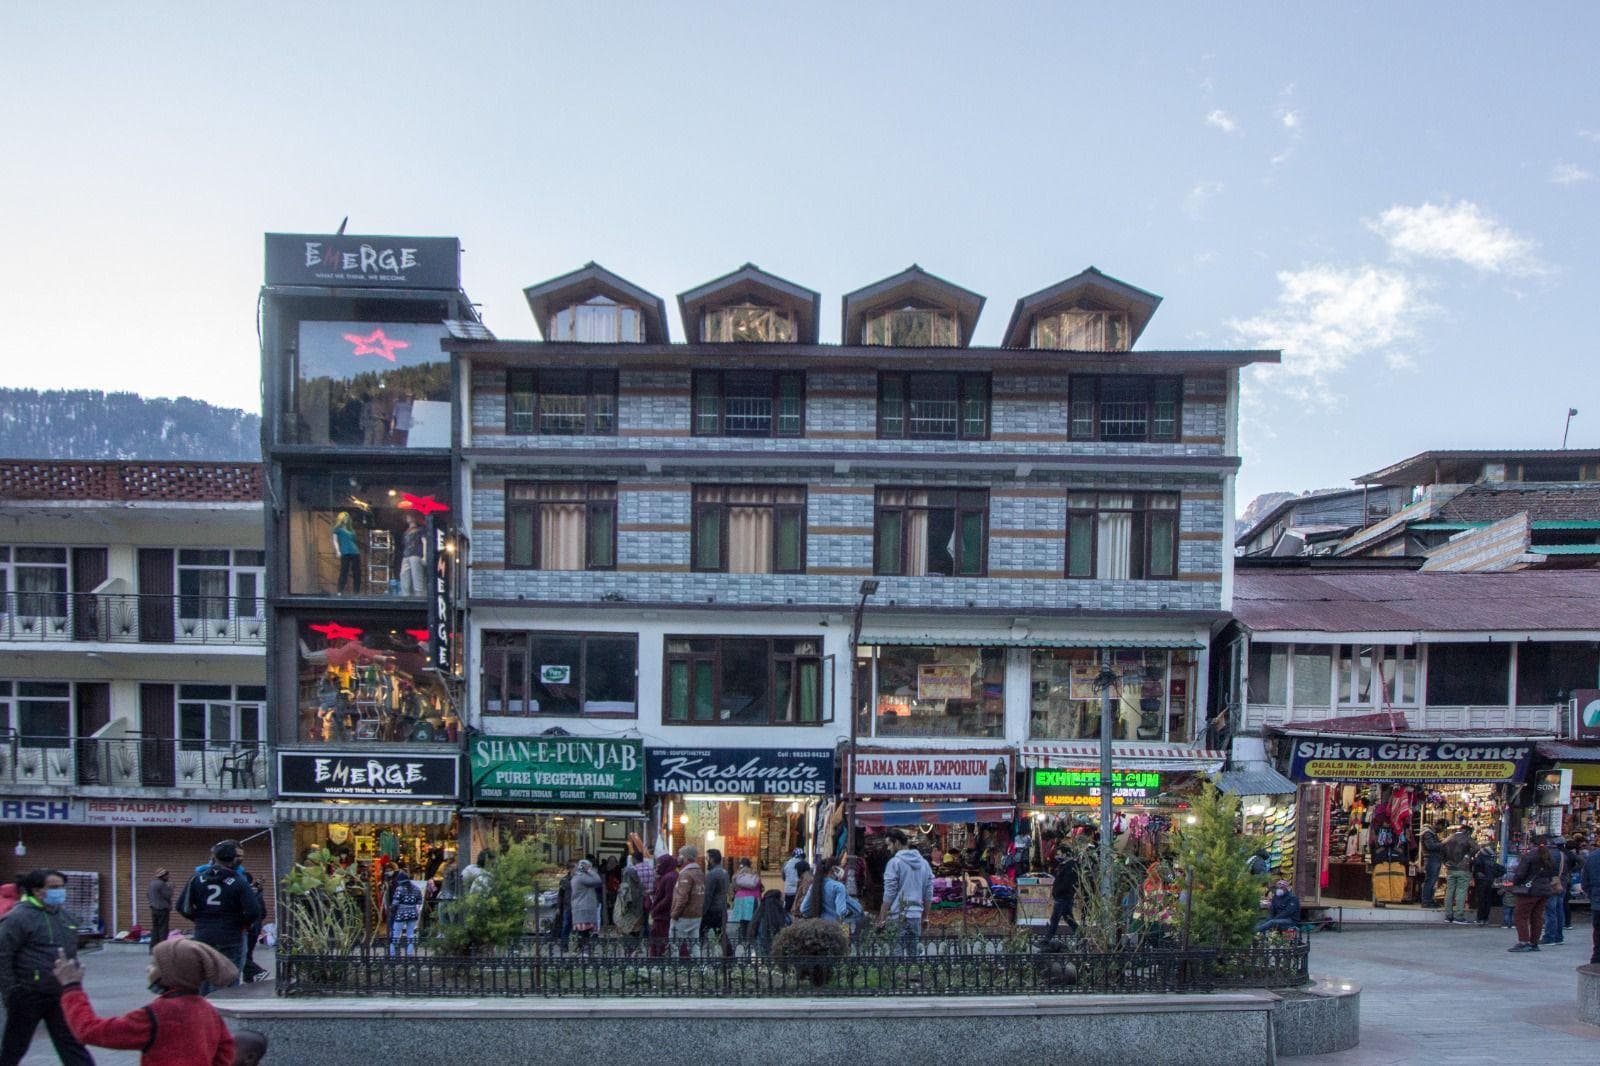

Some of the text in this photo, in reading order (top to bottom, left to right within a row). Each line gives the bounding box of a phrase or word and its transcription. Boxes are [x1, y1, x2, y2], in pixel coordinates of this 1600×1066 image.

[476, 740, 637, 772] SHAN-E-PUNJAB
[1298, 741, 1530, 761] Shiva Gift Corner
[661, 755, 820, 779] Kashmir
[896, 760, 932, 776] SHAWL
[933, 760, 988, 776] EMPORIUM
[1313, 769, 1358, 777] KASHMIRI
[1443, 770, 1483, 778] JACKETS
[1420, 763, 1463, 771] SHAWLS,
[1466, 763, 1508, 771] SAREES,
[496, 771, 615, 787] PURE VEGETARIAN
[1035, 771, 1122, 787] EXHIBITIN
[654, 779, 826, 794] HANDLOOM HOUSE
[873, 781, 962, 791] MALL ROAD MANALI
[1089, 787, 1146, 797] EUSIVE
[1537, 783, 1560, 791] SONY
[481, 789, 503, 797] INDIAN
[509, 790, 531, 798] SOUTH
[532, 790, 553, 799] INDIAN
[593, 791, 619, 800] PUNJABI
[619, 792, 637, 800] FOOD
[88, 802, 189, 814] RESTAURANT
[208, 804, 257, 814] HOTEL
[206, 884, 222, 906] 2
